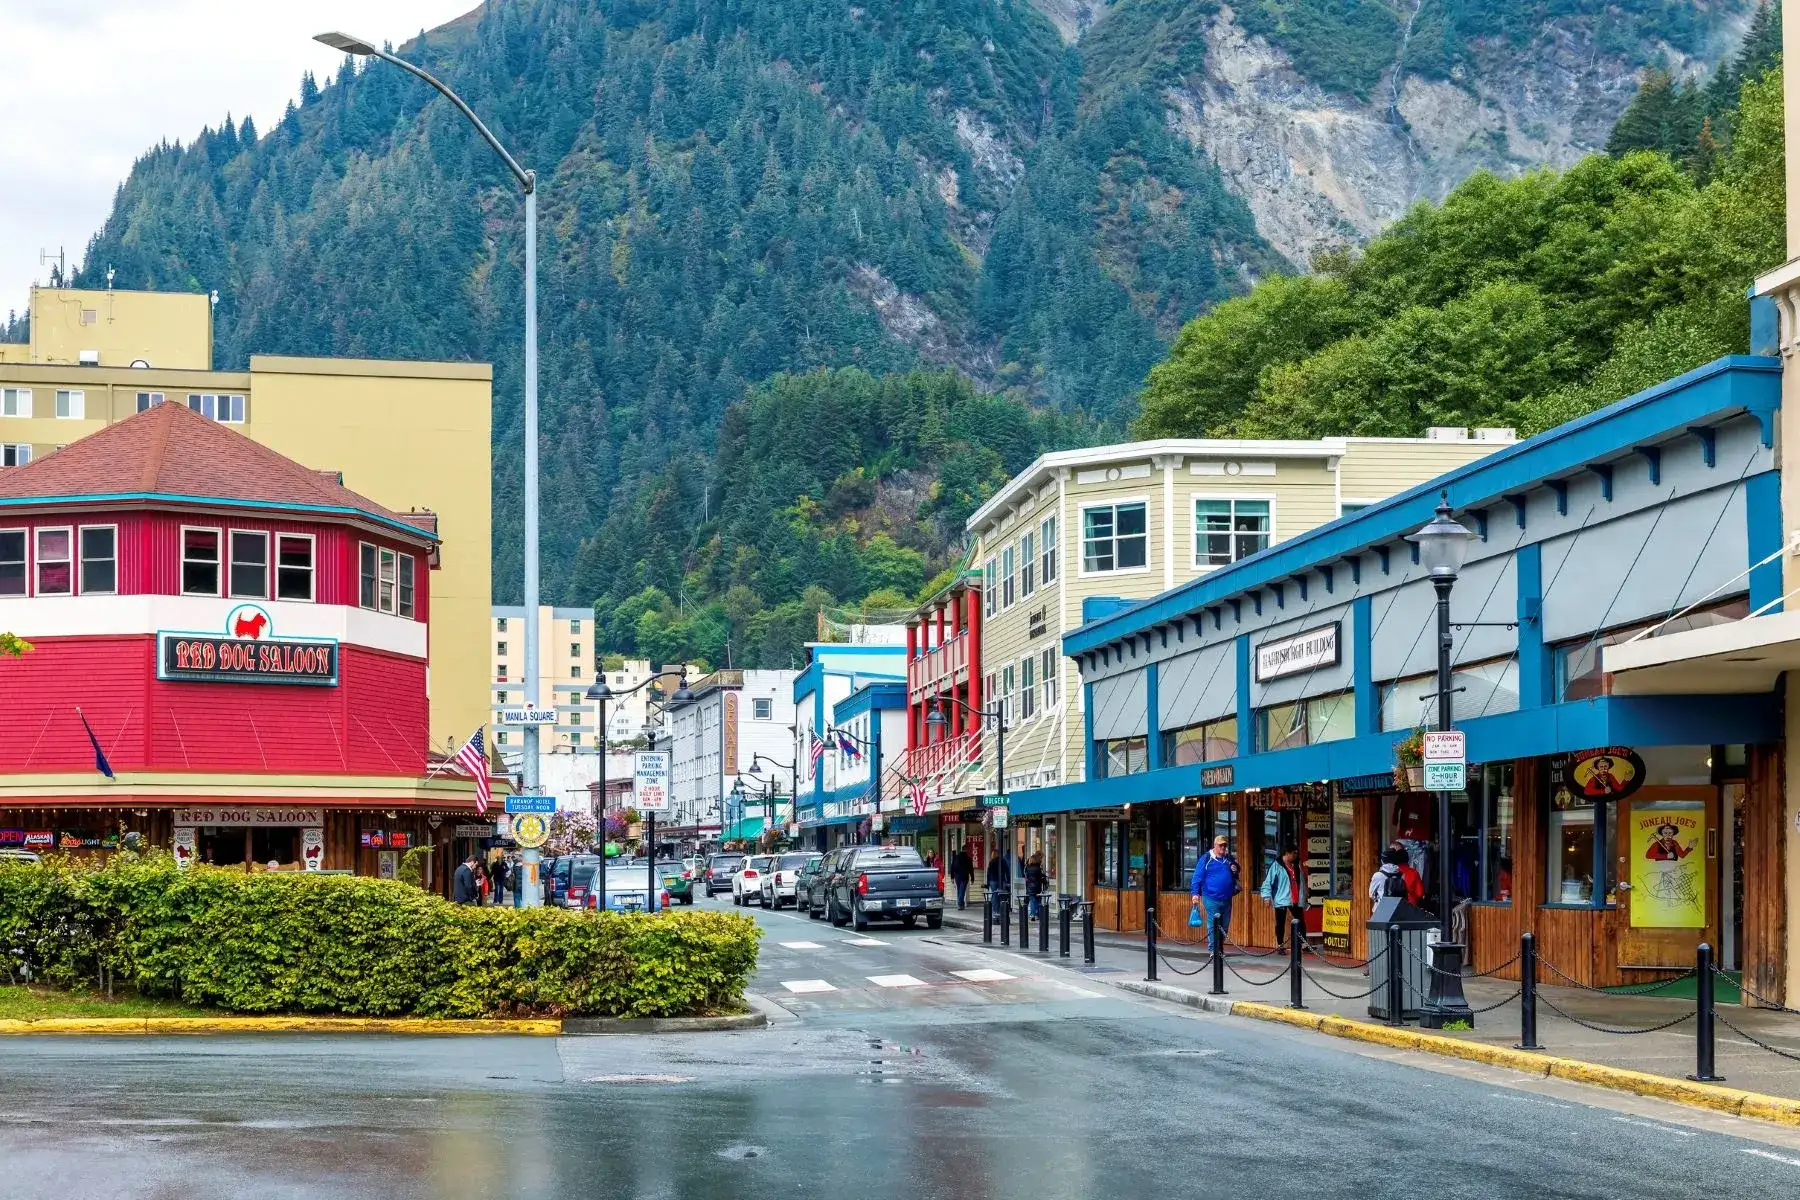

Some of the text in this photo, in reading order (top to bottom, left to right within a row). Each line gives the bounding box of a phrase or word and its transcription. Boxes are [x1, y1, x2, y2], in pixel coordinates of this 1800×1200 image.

[1306, 635, 1334, 656] BUILDING
[176, 640, 330, 674] RED DOG SALOON
[505, 712, 554, 720] MANILA SQUARE
[1576, 747, 1604, 761] JUNEAU
[180, 811, 318, 822] RED DOG SALOON
[1640, 816, 1696, 830] JUNEAU JOE'S
[1328, 936, 1346, 948] OUTLET
